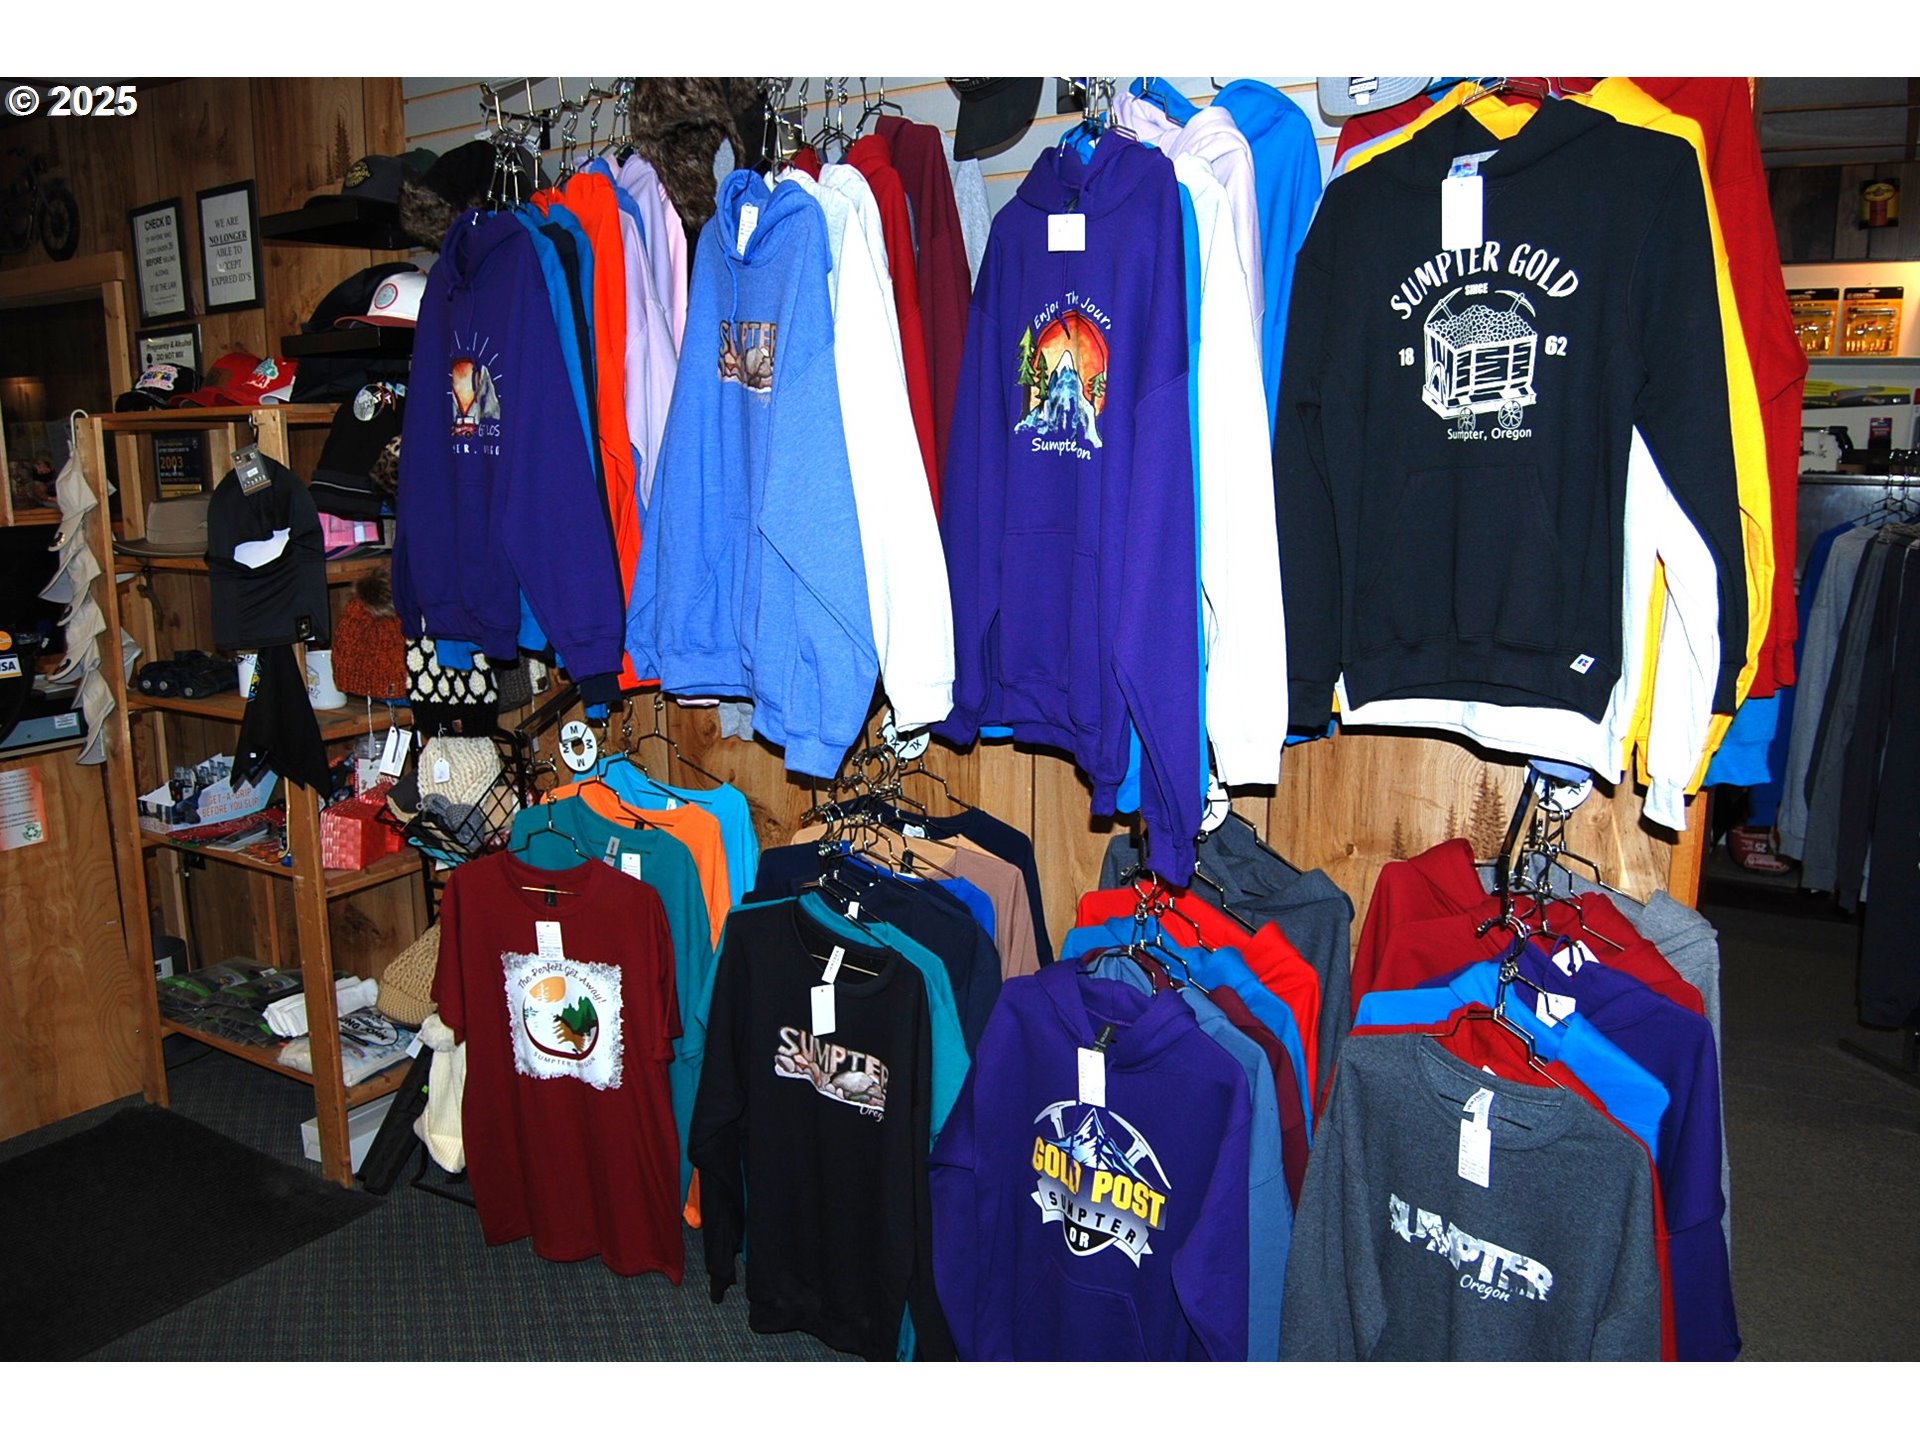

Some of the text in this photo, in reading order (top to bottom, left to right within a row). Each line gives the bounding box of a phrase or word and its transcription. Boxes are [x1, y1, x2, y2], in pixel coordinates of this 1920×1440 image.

[144, 214, 172, 231] CHECK ID
[214, 216, 240, 228] WE ARE
[209, 230, 247, 246] NO LONGER
[216, 245, 243, 257] ABLE TO
[211, 274, 238, 287] EXPIRED
[1390, 240, 1579, 320] SUMPTER GOLD
[1465, 283, 1488, 296] SINCE
[1080, 297, 1112, 330] Jour
[1398, 335, 1568, 367] 18 62
[1490, 427, 1532, 441] Oregon
[1031, 437, 1078, 456] Sumpte
[159, 455, 185, 470] 2003
[0, 661, 17, 672] SA
[202, 804, 228, 818] BEFORE
[229, 801, 243, 813] YOU
[517, 975, 532, 990] The
[578, 977, 607, 1004] Away!
[777, 1026, 889, 1095] SUMPTER
[859, 1105, 885, 1122] Oreg
[1031, 1135, 1166, 1228] GOLD POST
[1048, 1191, 1137, 1244] SUMPTER
[1069, 1227, 1090, 1249] OR
[1460, 1273, 1511, 1302] Oregon
